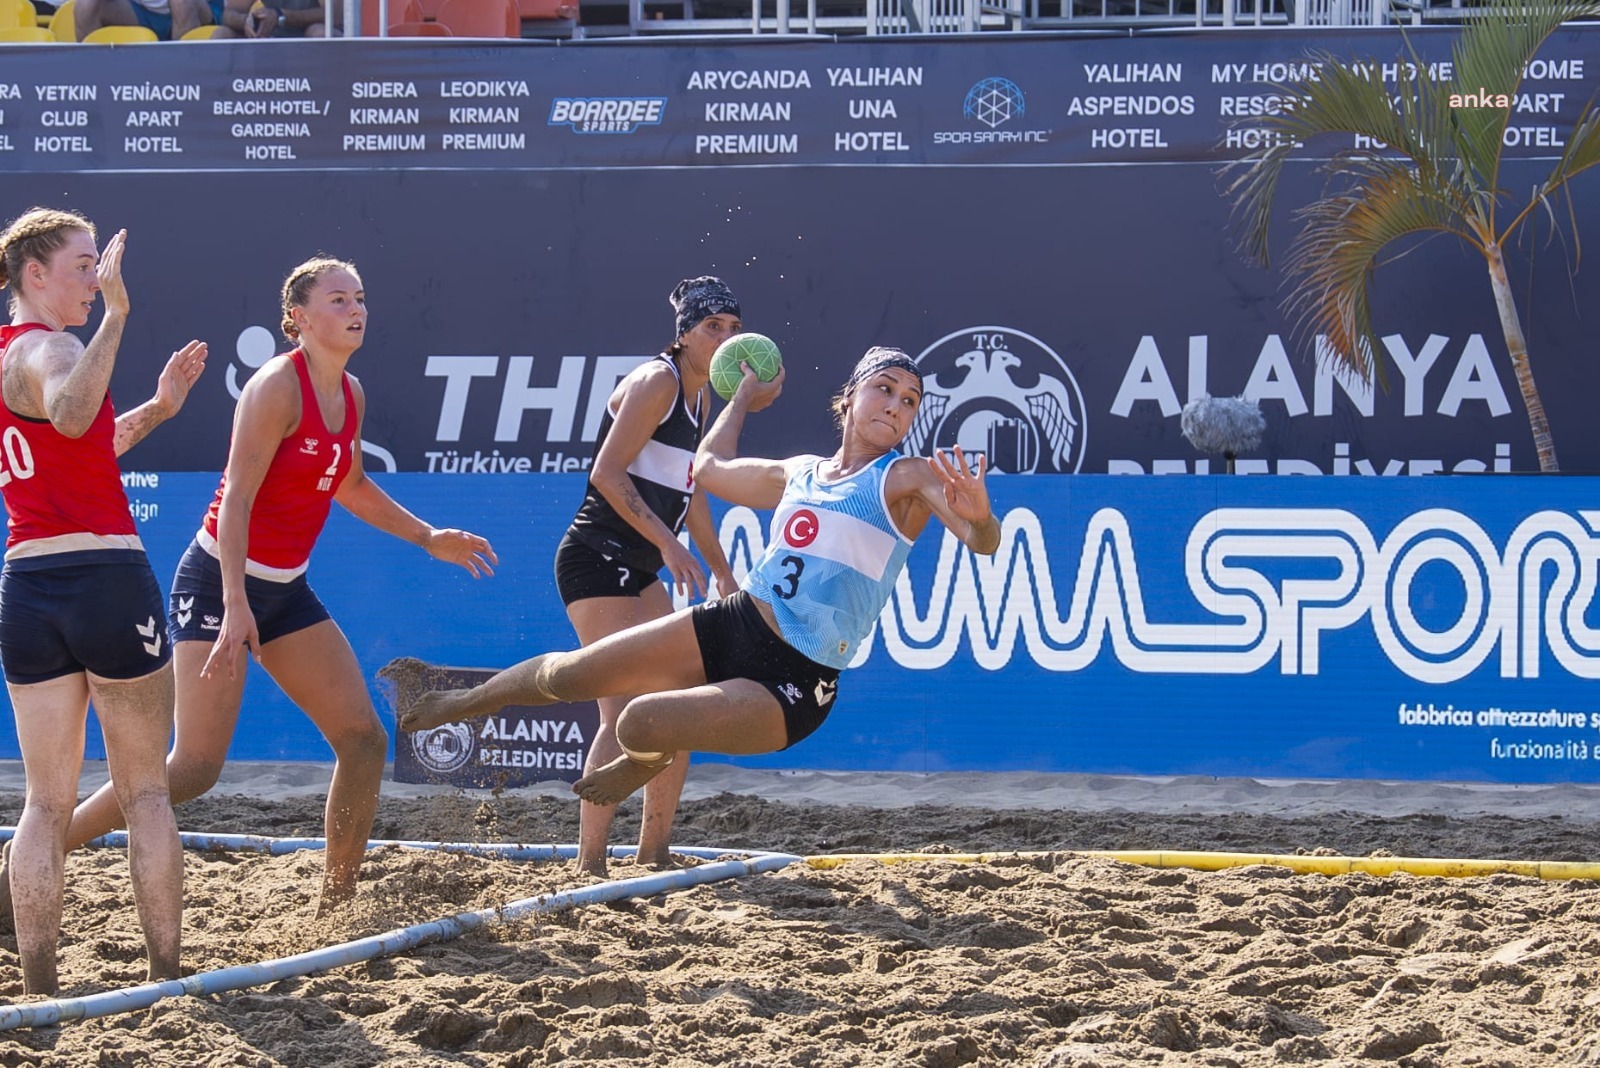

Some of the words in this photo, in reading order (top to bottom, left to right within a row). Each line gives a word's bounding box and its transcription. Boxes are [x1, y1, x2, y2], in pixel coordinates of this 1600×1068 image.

[687, 70, 811, 89] ARYCANDA
[827, 67, 922, 86] YALIHAN
[1084, 64, 1181, 82] YALIHAN
[1212, 64, 1246, 82] MY
[1252, 62, 1323, 83] HOME
[35, 85, 96, 100] YETKIN
[111, 82, 200, 100] YENİACUN
[233, 79, 310, 92] GARDENIA
[352, 82, 417, 98] SIDERA
[441, 81, 529, 97] LEODIKYA
[214, 101, 266, 114] BEACH
[271, 101, 320, 114] HOTEL
[552, 100, 663, 121] BOARDEE
[706, 102, 790, 121] KIRMAN
[850, 100, 897, 118] UNA
[1068, 96, 1194, 115] ASPENDOS
[41, 111, 87, 126] CLUB
[126, 111, 182, 126] APART
[351, 109, 419, 124] KIRMAN
[450, 107, 519, 123] KIRMAN
[232, 123, 310, 137] GARDENIA
[582, 121, 630, 132] SPORTS
[35, 137, 92, 152] HOTEL
[125, 137, 182, 152] HOTEL
[344, 135, 425, 150] PREMIUM
[443, 134, 525, 149] PREMIUM
[696, 135, 797, 153] PREMIUM
[835, 132, 909, 151] HOTEL
[934, 132, 971, 143] SPOR
[1092, 129, 1167, 147] HOTEL
[1502, 126, 1564, 147] OTEL
[246, 146, 296, 159] HOTEL
[972, 332, 1010, 352] T.C.
[325, 443, 341, 476] 2
[129, 499, 159, 522] sign
[617, 567, 630, 588] 7
[772, 555, 805, 599] 3
[1399, 704, 1472, 725] fabbrica
[480, 718, 584, 744] ALANYA
